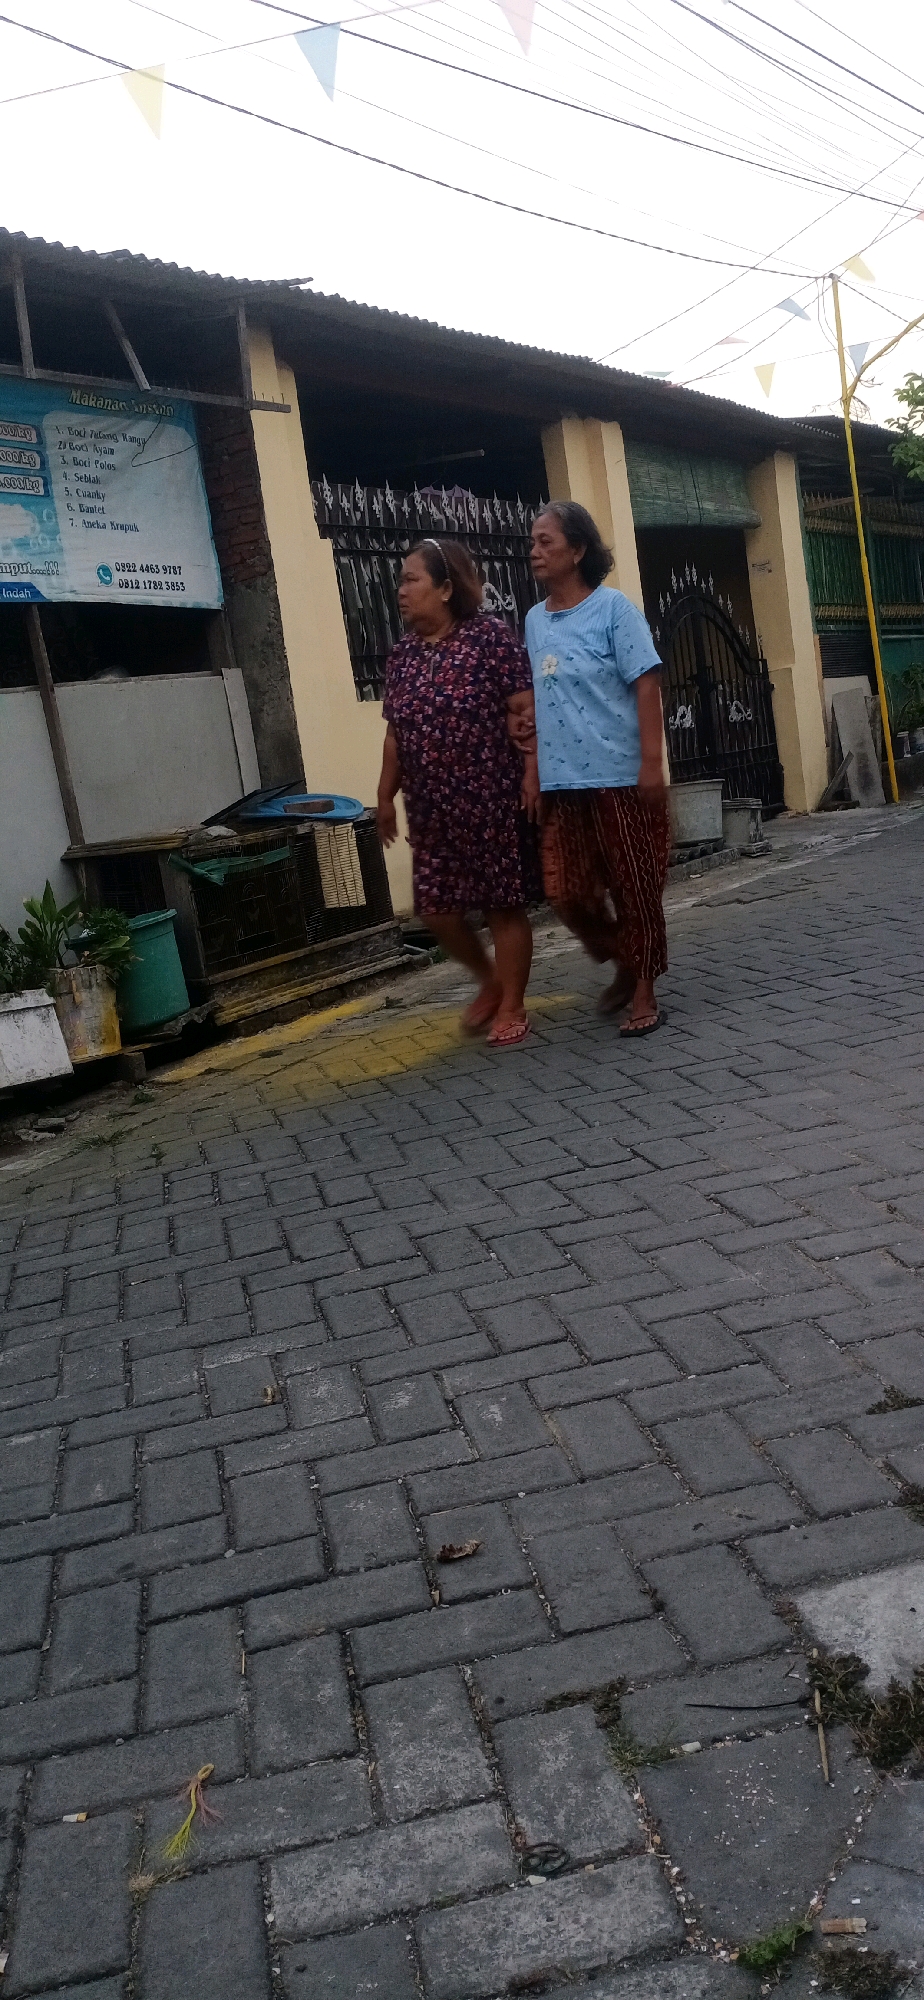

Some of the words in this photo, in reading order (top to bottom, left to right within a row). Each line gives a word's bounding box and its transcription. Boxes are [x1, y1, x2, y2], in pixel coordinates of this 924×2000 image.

[68, 388, 129, 411] Makanan
[0, 424, 32, 441] 00/kg
[67, 427, 86, 438] Boci
[90, 430, 119, 443] Tulang
[68, 442, 89, 452] Boci
[93, 444, 115, 456] Ayam
[60, 455, 69, 465] 3.
[73, 457, 91, 468] Boci
[94, 459, 116, 471] Polos
[62, 471, 71, 481] 4.
[74, 473, 101, 484] Seblak
[64, 486, 73, 497] 5.
[76, 487, 106, 502] Cuanky
[66, 503, 76, 512] 6.
[79, 503, 107, 515] Bantet
[69, 518, 78, 528] 7.
[81, 519, 107, 530] Aneka
[110, 520, 140, 533] Krupuk
[139, 562, 160, 574] 4463
[162, 563, 182, 576] 9787
[118, 578, 140, 590] 0812
[143, 579, 164, 591] 1782
[166, 580, 186, 592] 3853
[2, 588, 31, 599] Indah
